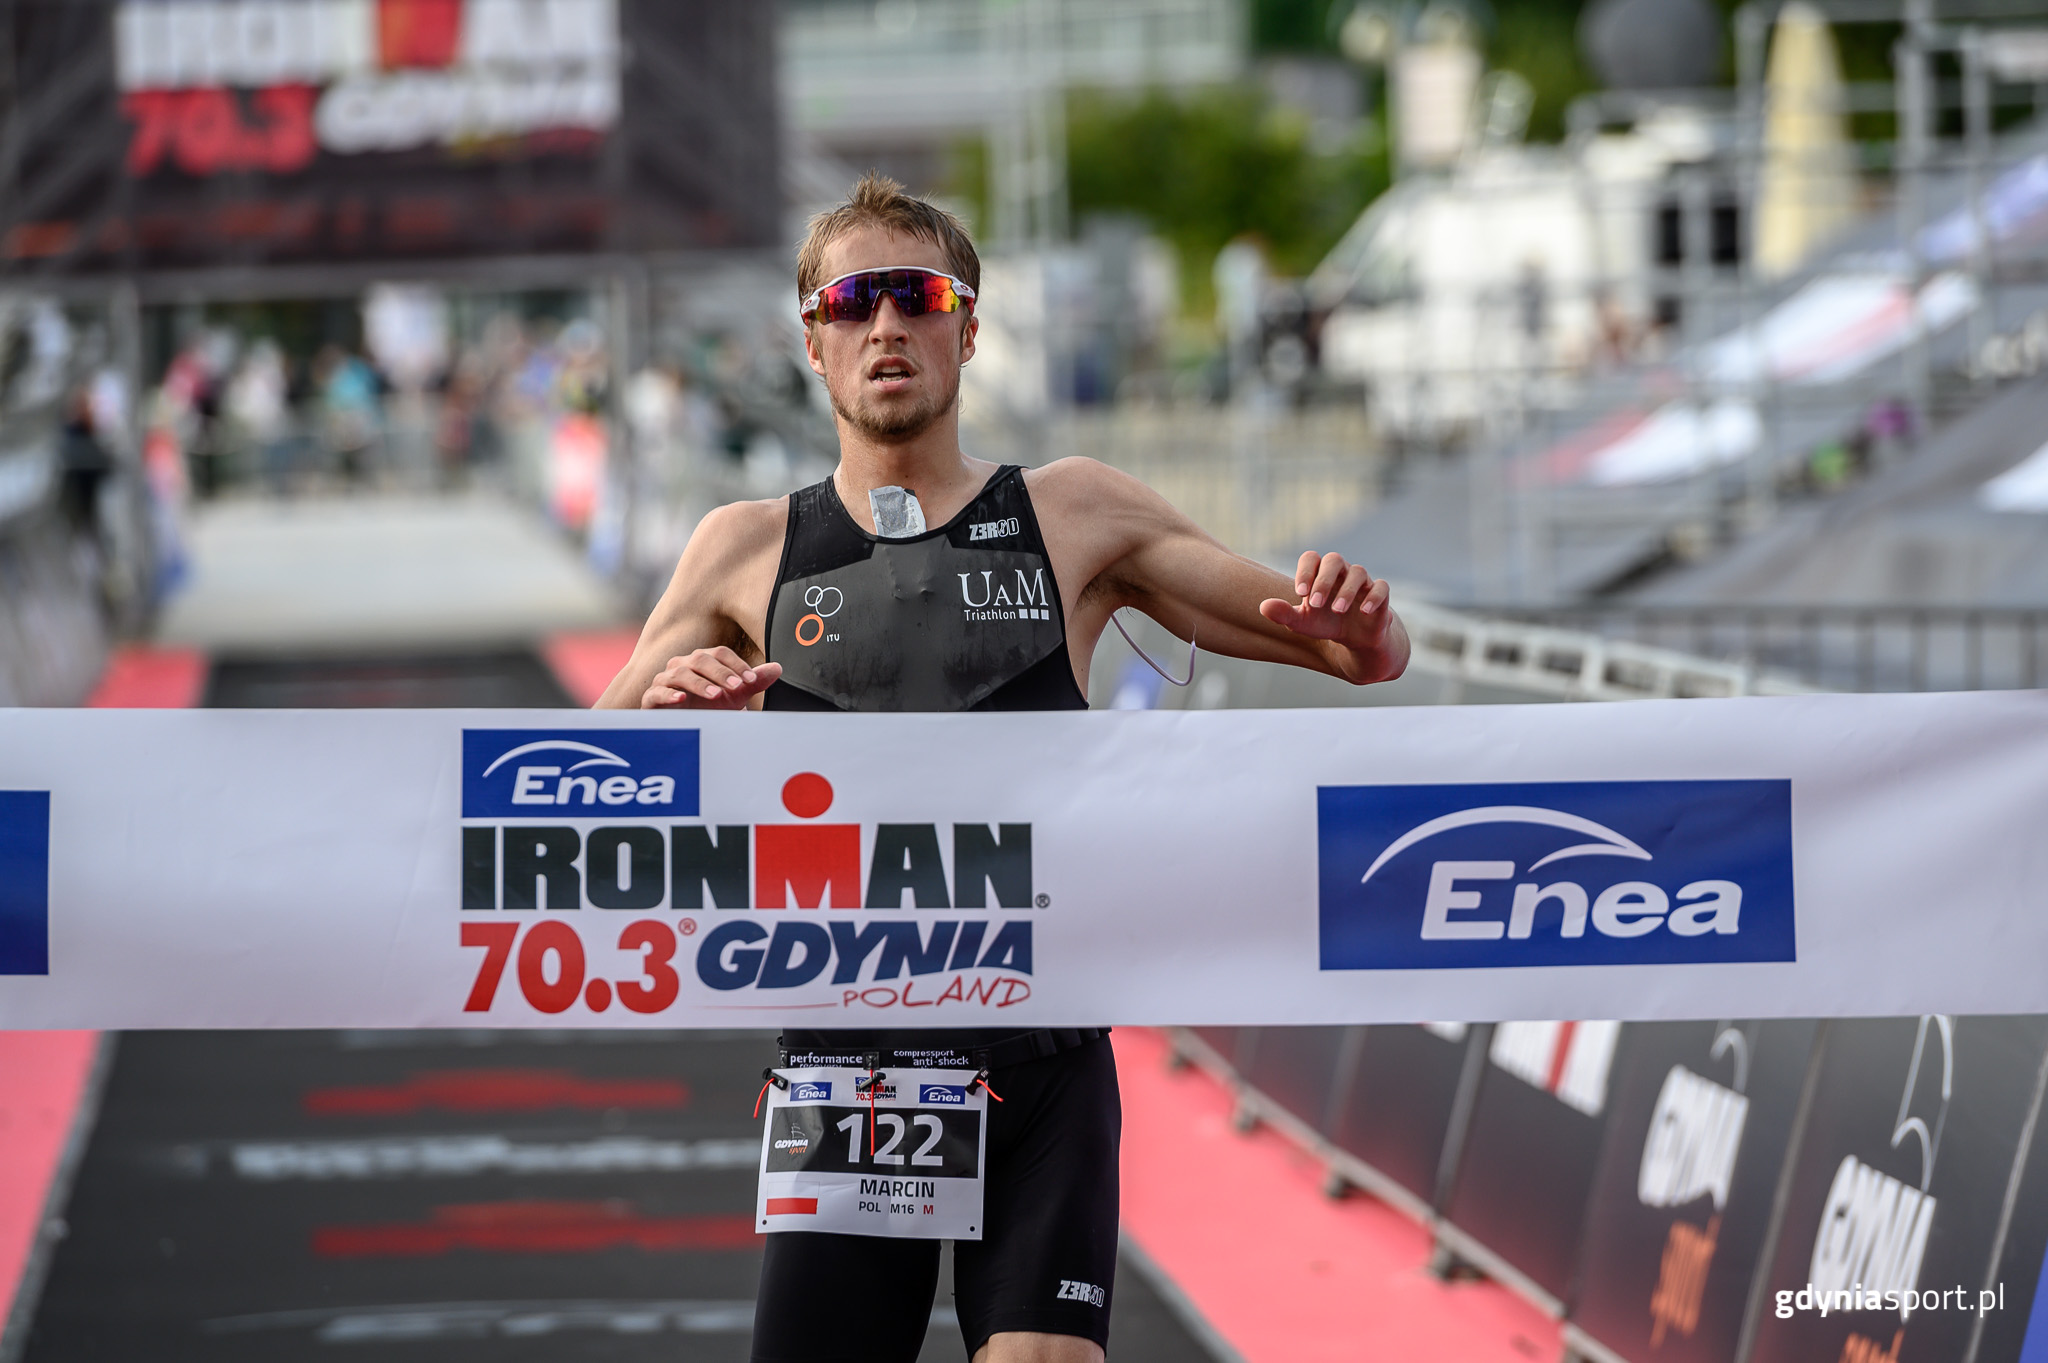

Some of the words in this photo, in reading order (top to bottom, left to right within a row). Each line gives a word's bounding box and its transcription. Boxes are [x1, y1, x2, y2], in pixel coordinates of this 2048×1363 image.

[964, 608, 1016, 622] Triathlon
[826, 633, 840, 642] ITU
[511, 765, 676, 805] Enea
[460, 822, 1033, 910] IRONMAN
[1419, 860, 1744, 941] Enea
[459, 918, 681, 1014] 70.3
[695, 919, 1034, 991] GDYNIA
[843, 974, 1033, 1009] POLAND
[790, 1052, 864, 1067] performance
[913, 1055, 969, 1067] anti-shock
[798, 1089, 827, 1099] Enea
[928, 1091, 961, 1103] Enea
[774, 1138, 809, 1149] GDYNIA
[836, 1113, 944, 1167] 122
[859, 1178, 935, 1198] MARCIN
[858, 1201, 882, 1213] POL
[890, 1203, 915, 1215] M16
[922, 1204, 934, 1215] M
